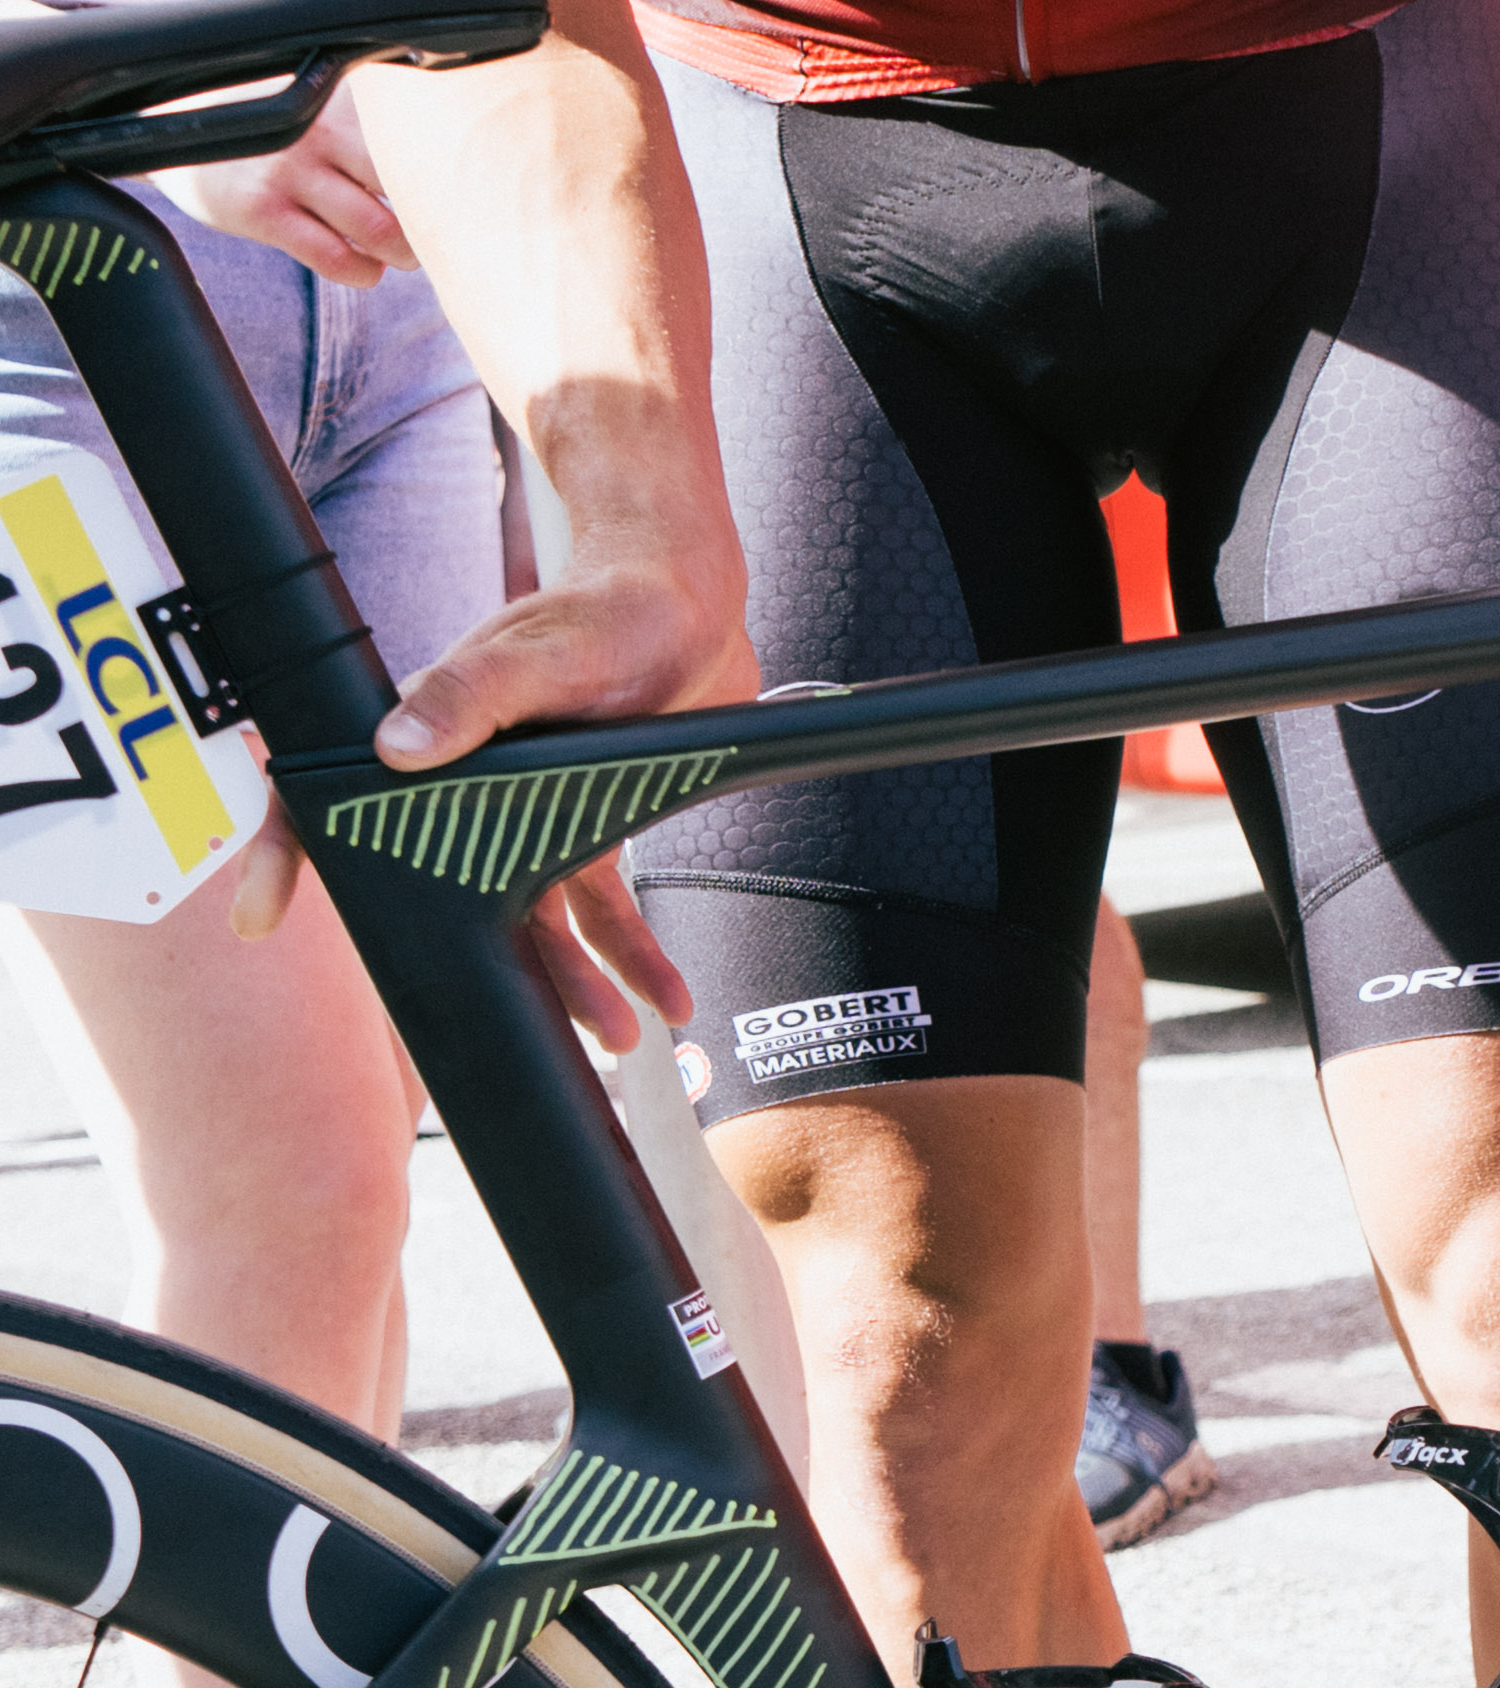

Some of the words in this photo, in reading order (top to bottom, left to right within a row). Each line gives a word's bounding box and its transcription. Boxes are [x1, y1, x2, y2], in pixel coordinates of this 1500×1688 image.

[56, 581, 178, 782] LCL
[744, 991, 911, 1036] GOBERT
[750, 1031, 824, 1053] GROUPE
[833, 1016, 916, 1036] GOBERT
[752, 1033, 918, 1078] MATERIAUX
[1409, 1436, 1469, 1469] Tacx
